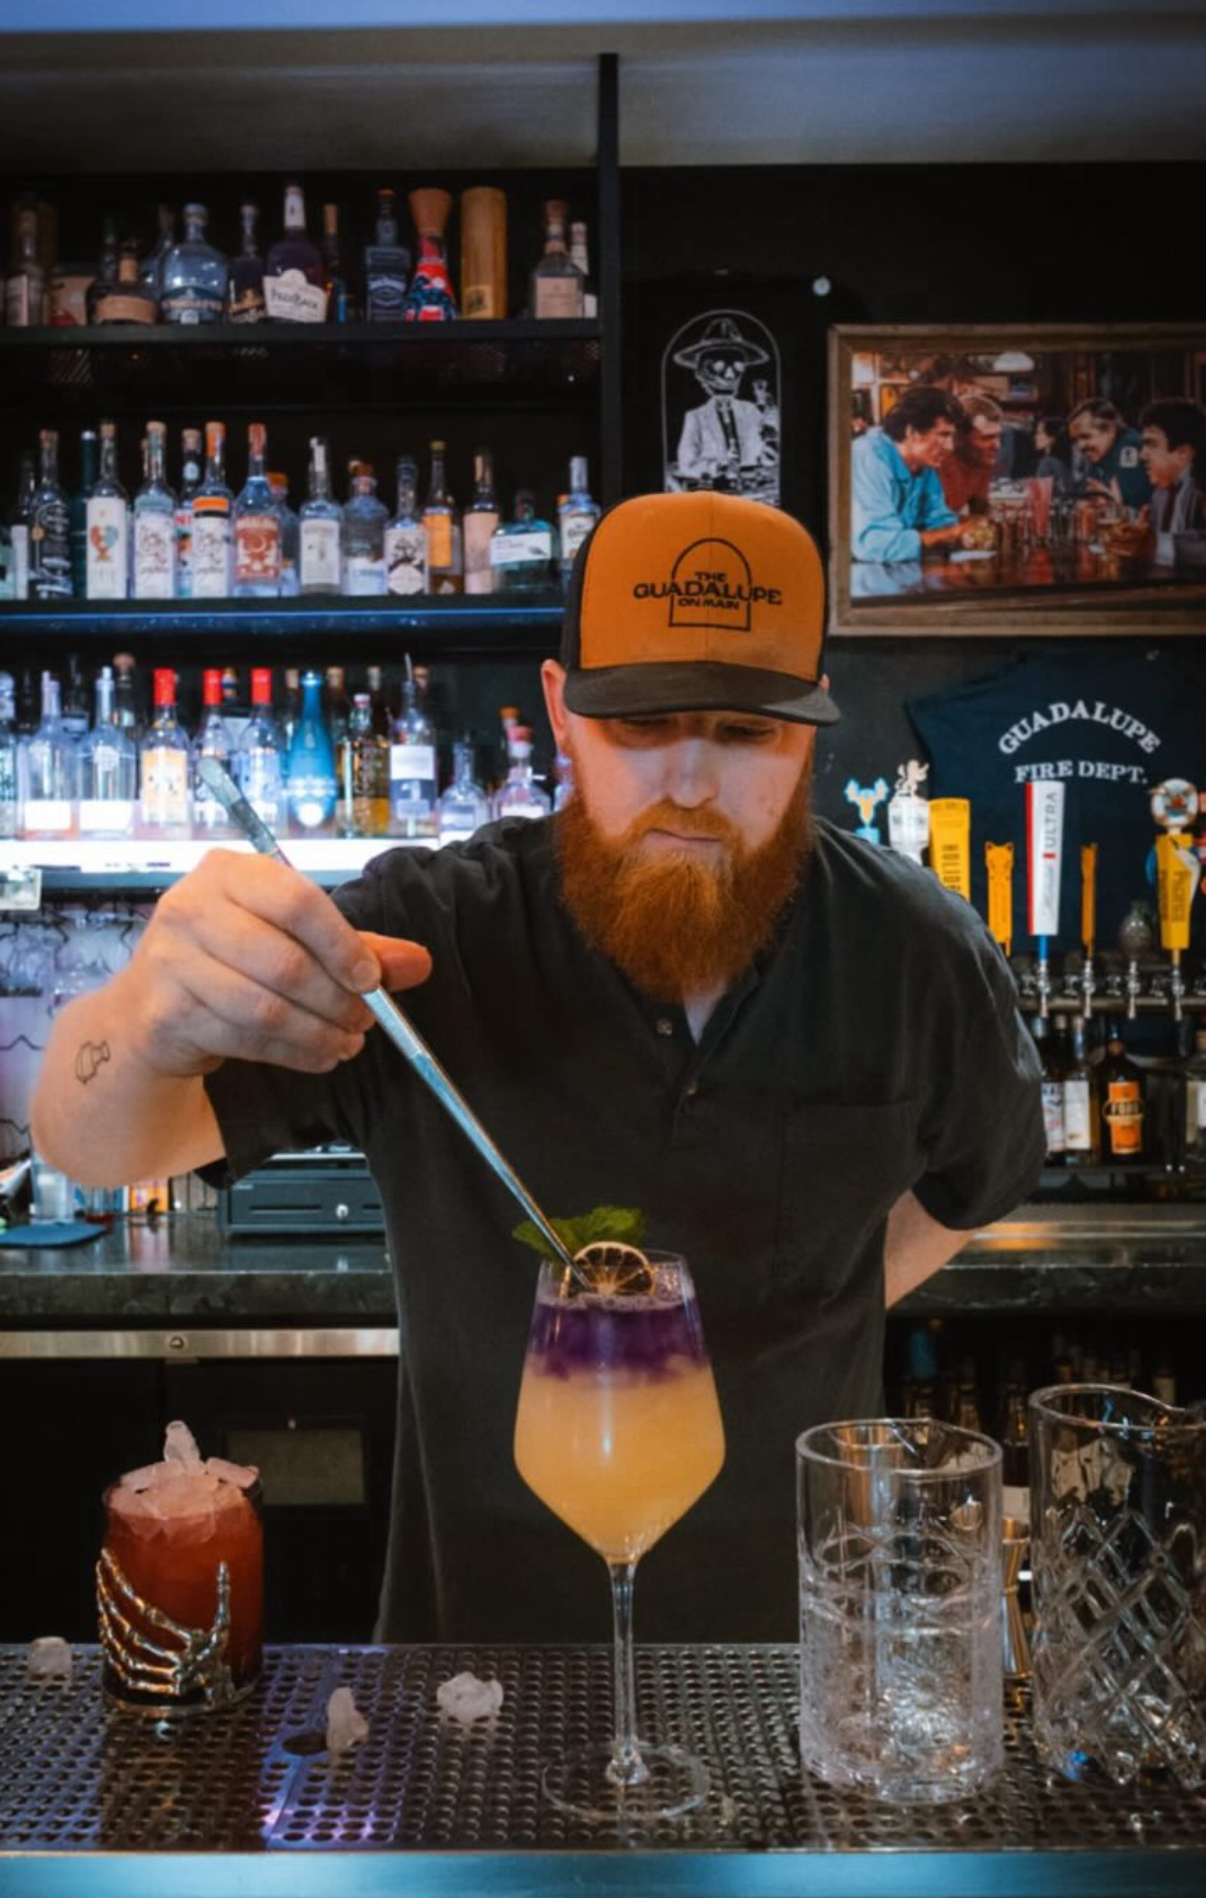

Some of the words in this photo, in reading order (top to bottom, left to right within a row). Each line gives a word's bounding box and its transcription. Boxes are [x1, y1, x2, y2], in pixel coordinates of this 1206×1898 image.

[694, 571, 727, 583] THE
[633, 581, 783, 606] GUADALUPE
[678, 598, 700, 608] ON
[702, 599, 740, 610] MAIN
[998, 699, 1161, 754] GUADALUPE
[1014, 759, 1073, 784] FIRE
[1077, 760, 1148, 785] DEPT.
[1044, 791, 1057, 850] ULTRA
